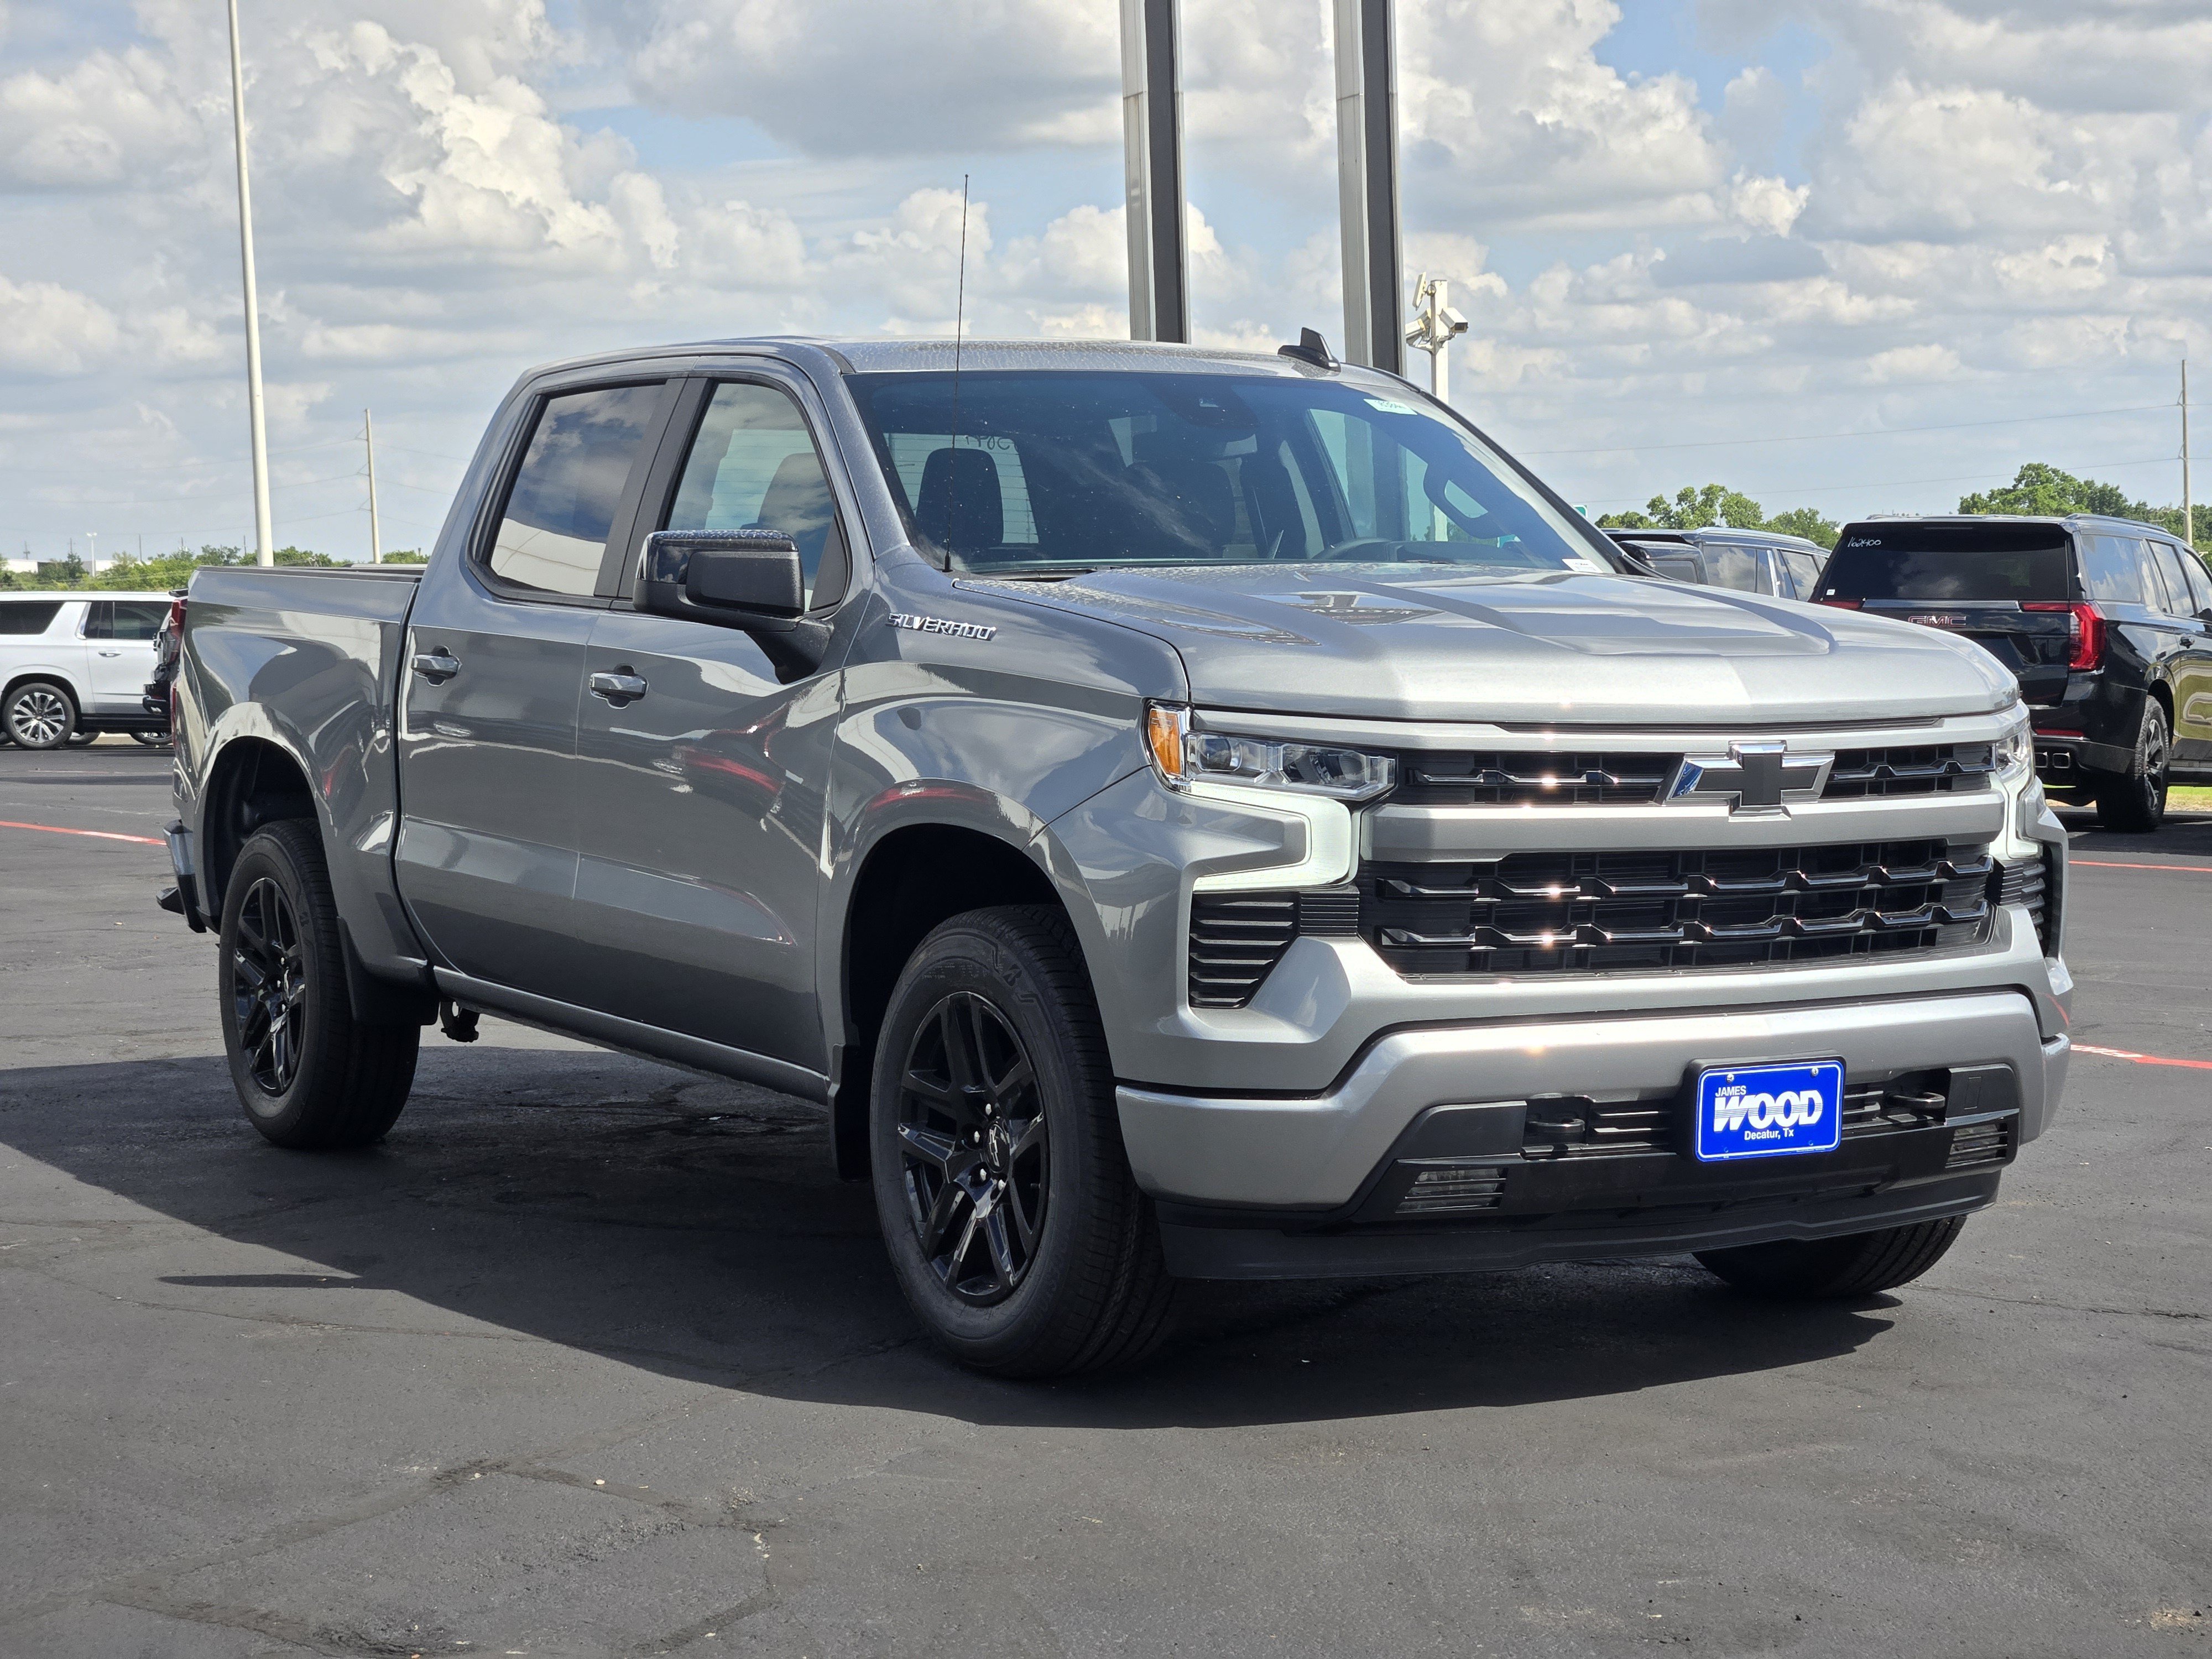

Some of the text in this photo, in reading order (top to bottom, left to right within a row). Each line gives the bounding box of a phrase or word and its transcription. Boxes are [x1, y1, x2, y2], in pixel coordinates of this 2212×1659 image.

[886, 613, 997, 640] SILVERADO
[1908, 615, 1966, 627] GMC
[1715, 1085, 1747, 1097] JAMES
[1713, 1089, 1823, 1132] WOOD
[1744, 1127, 1794, 1141] Decatur, Tx
